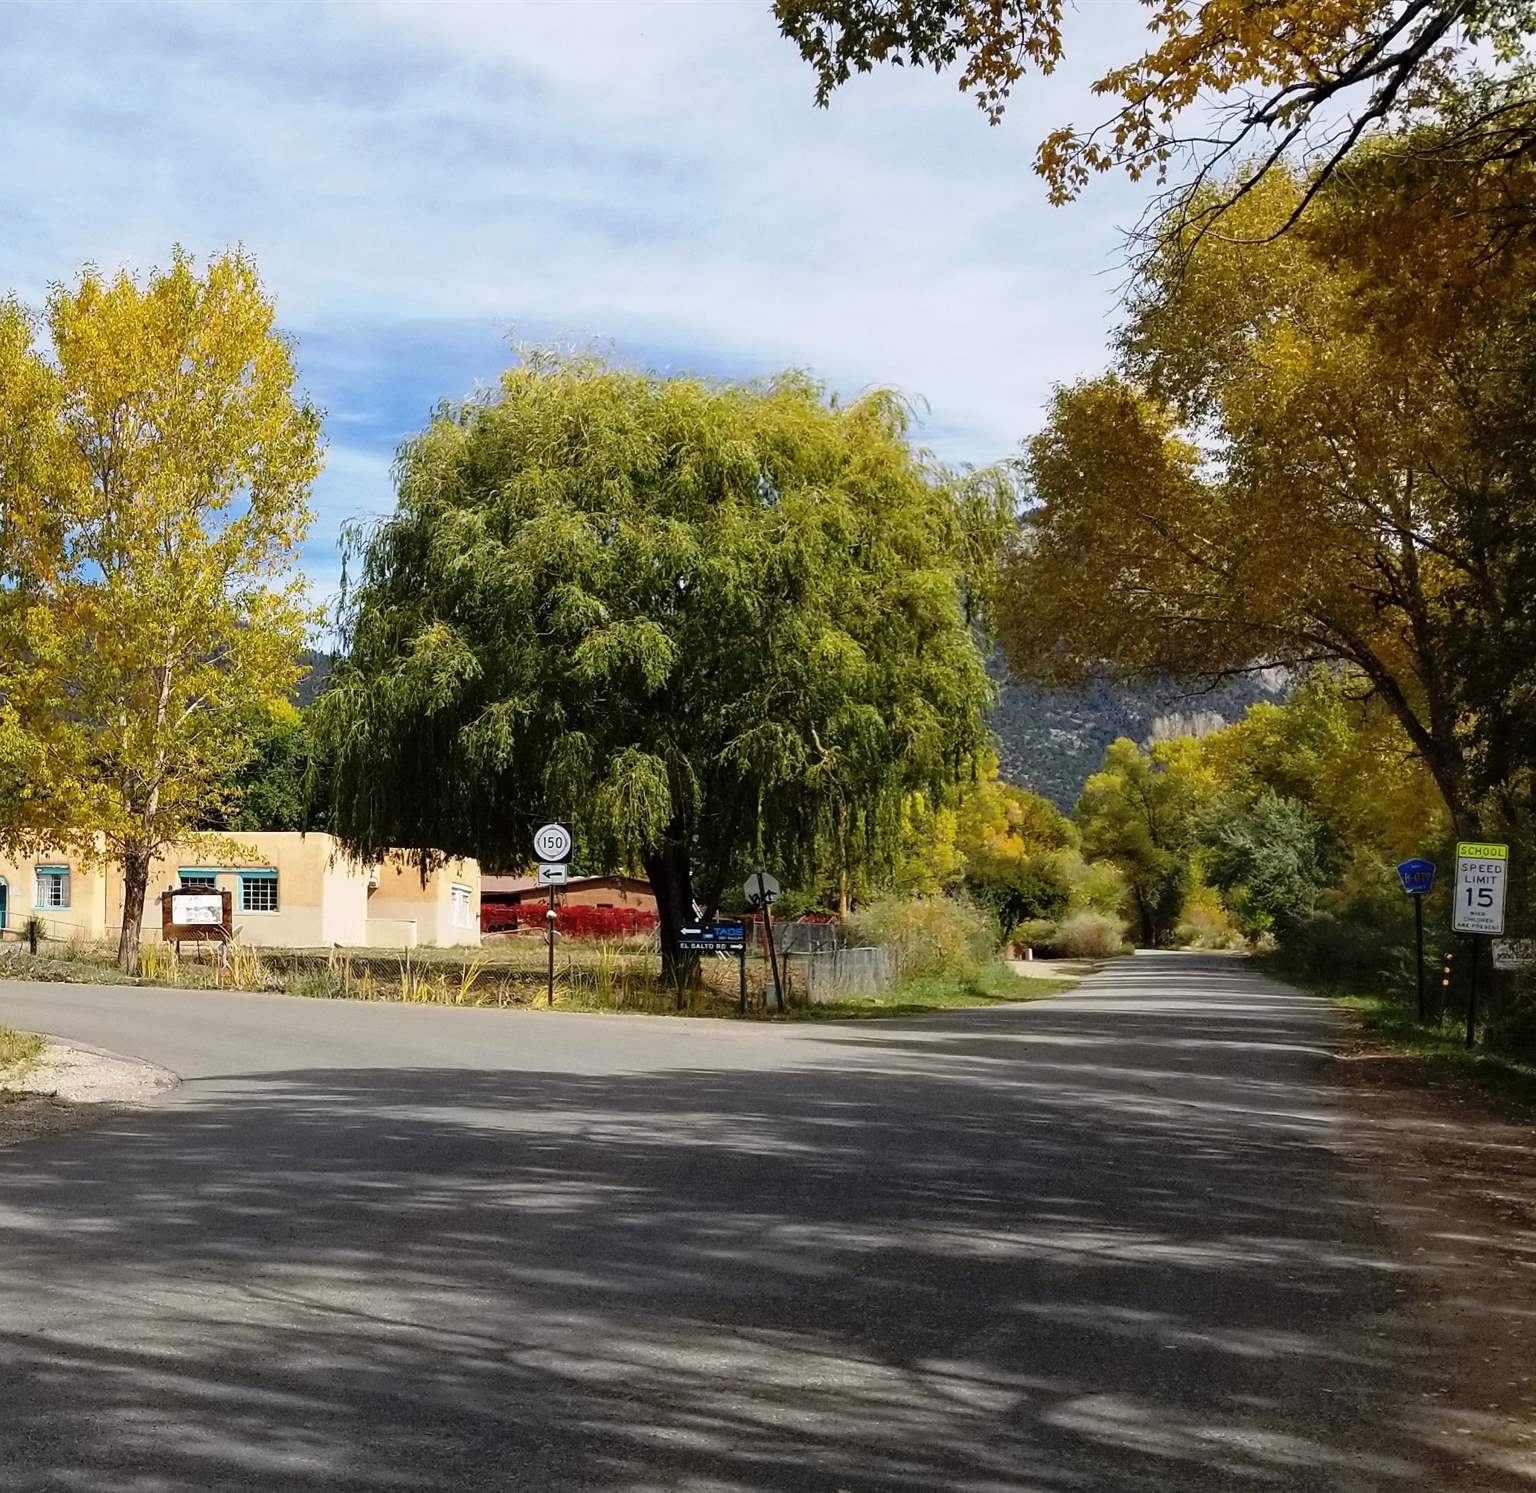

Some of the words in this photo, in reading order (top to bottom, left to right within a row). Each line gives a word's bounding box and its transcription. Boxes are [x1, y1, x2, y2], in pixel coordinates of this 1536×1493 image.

[543, 837, 562, 848] 150
[1460, 845, 1505, 857] SCHOOL
[1461, 863, 1502, 874] SPEED
[1464, 875, 1497, 885] LIMIT
[1465, 887, 1494, 908] 15
[713, 927, 743, 936] TAOS
